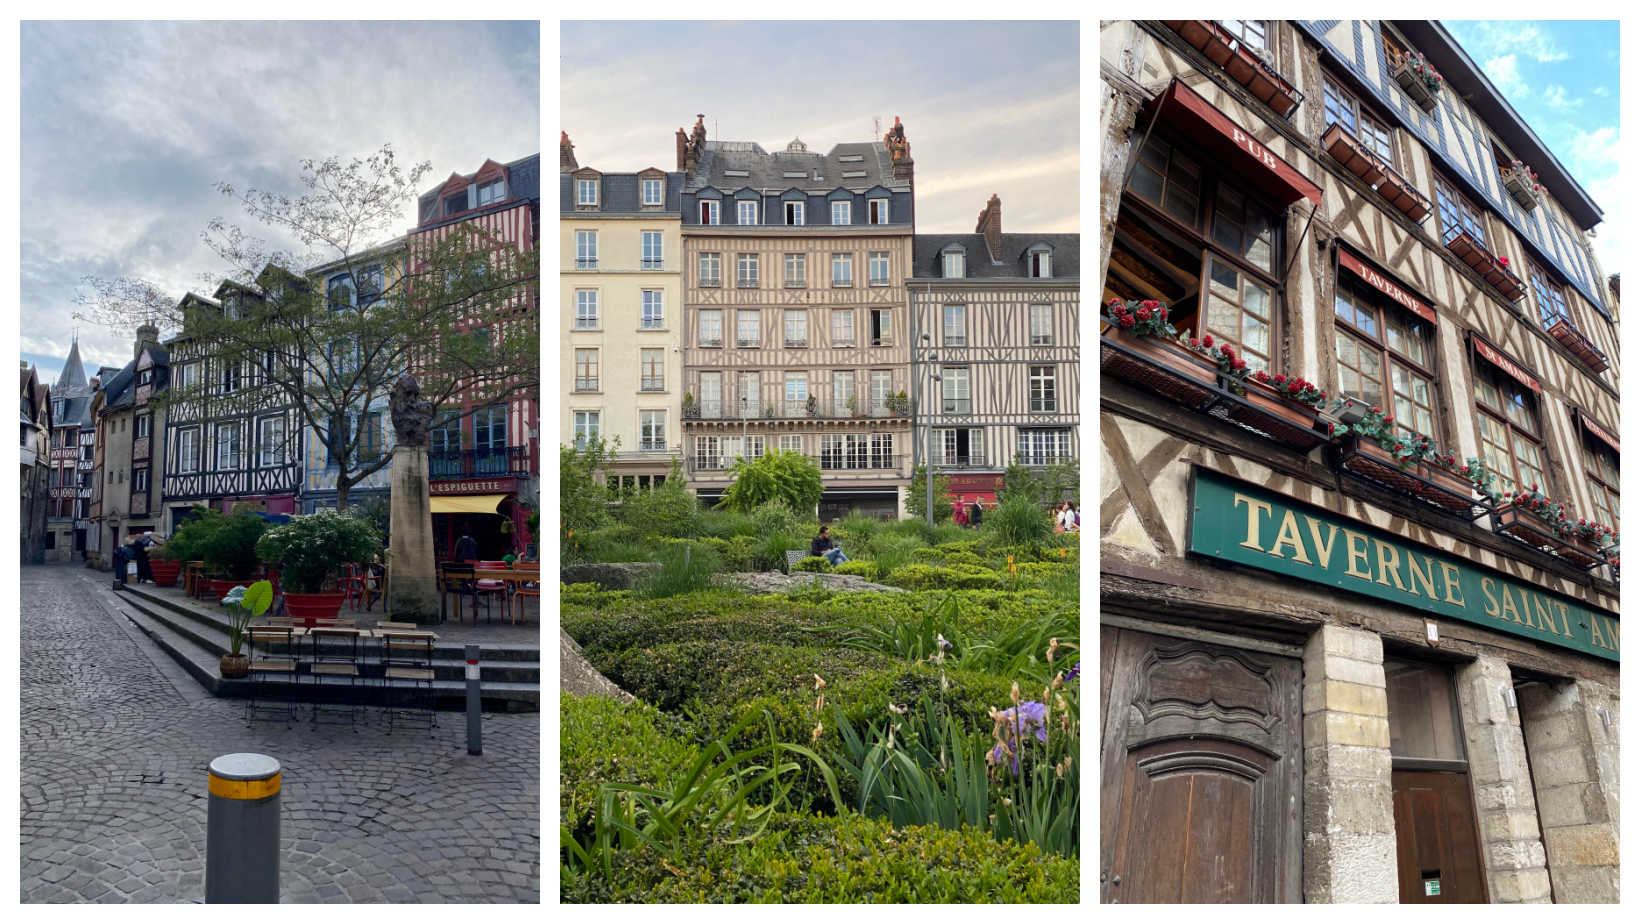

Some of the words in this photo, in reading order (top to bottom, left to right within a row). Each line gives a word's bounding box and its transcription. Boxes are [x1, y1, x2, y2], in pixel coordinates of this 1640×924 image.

[1232, 128, 1276, 169] PUB
[1357, 262, 1421, 314] TAVERNE
[430, 481, 500, 492] L'ESPIGUETTE
[1234, 492, 1466, 608] TAVERNE
[1482, 577, 1575, 639] SAINT
